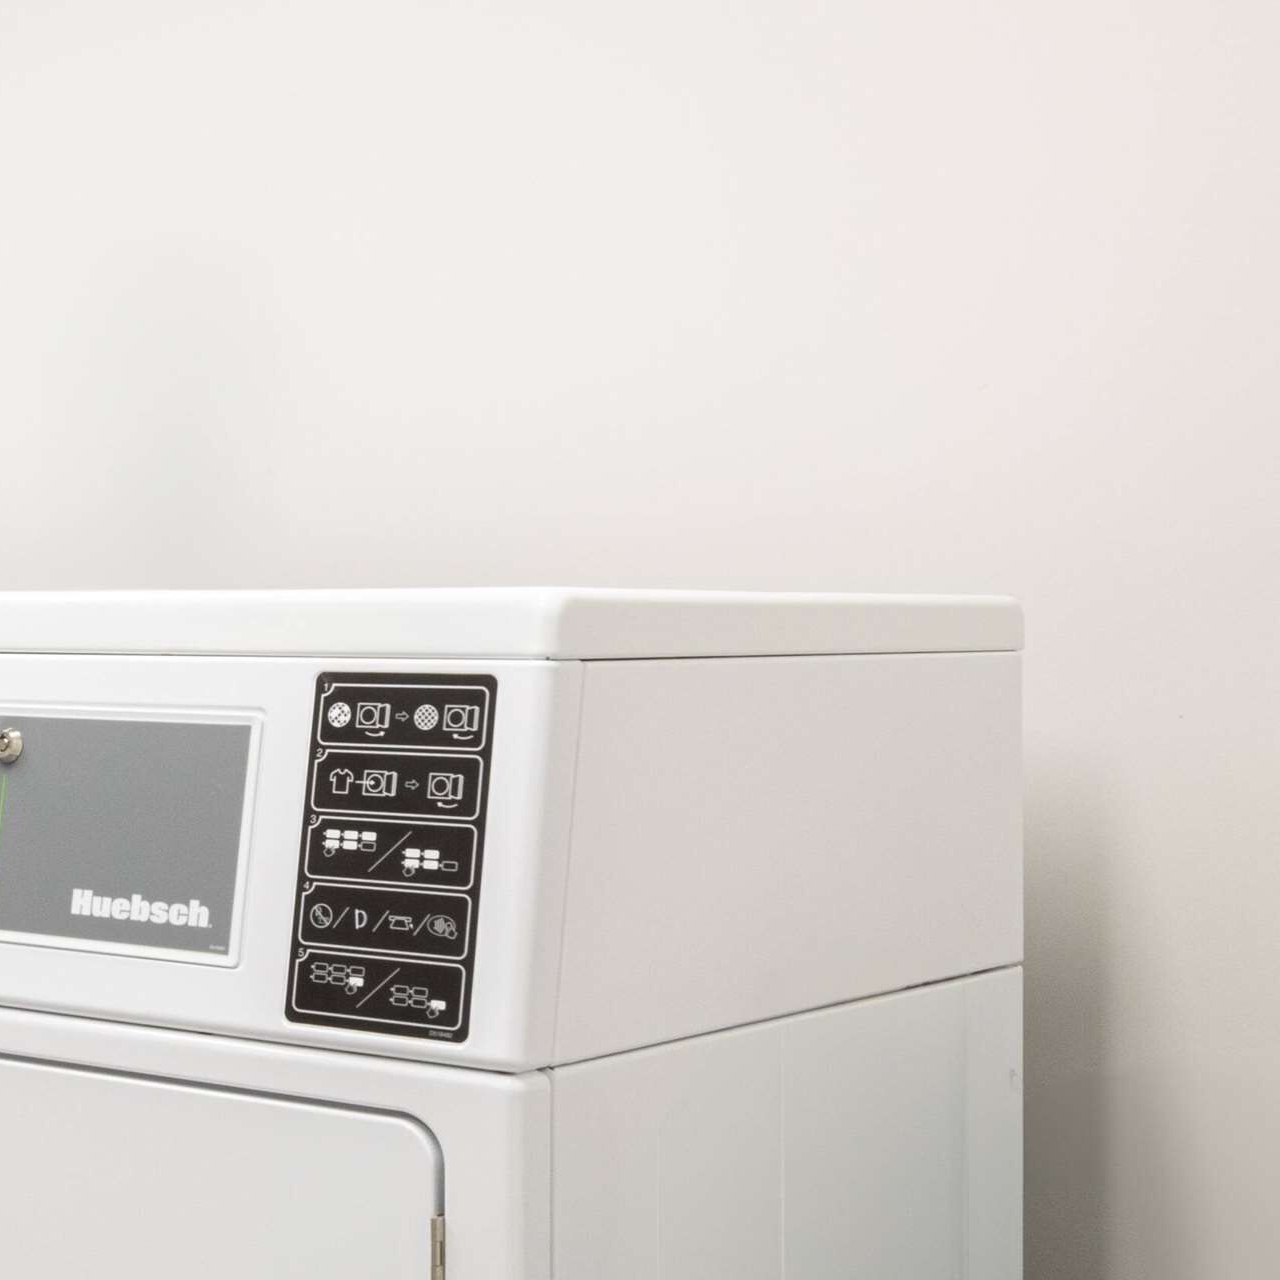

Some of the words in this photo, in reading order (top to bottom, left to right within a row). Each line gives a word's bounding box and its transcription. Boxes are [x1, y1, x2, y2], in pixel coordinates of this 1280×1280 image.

[324, 682, 329, 692] 1
[316, 748, 323, 758] 2
[310, 814, 317, 824] 3
[303, 881, 310, 890] 4
[70, 888, 211, 928] Huebsch
[298, 947, 305, 957] 5
